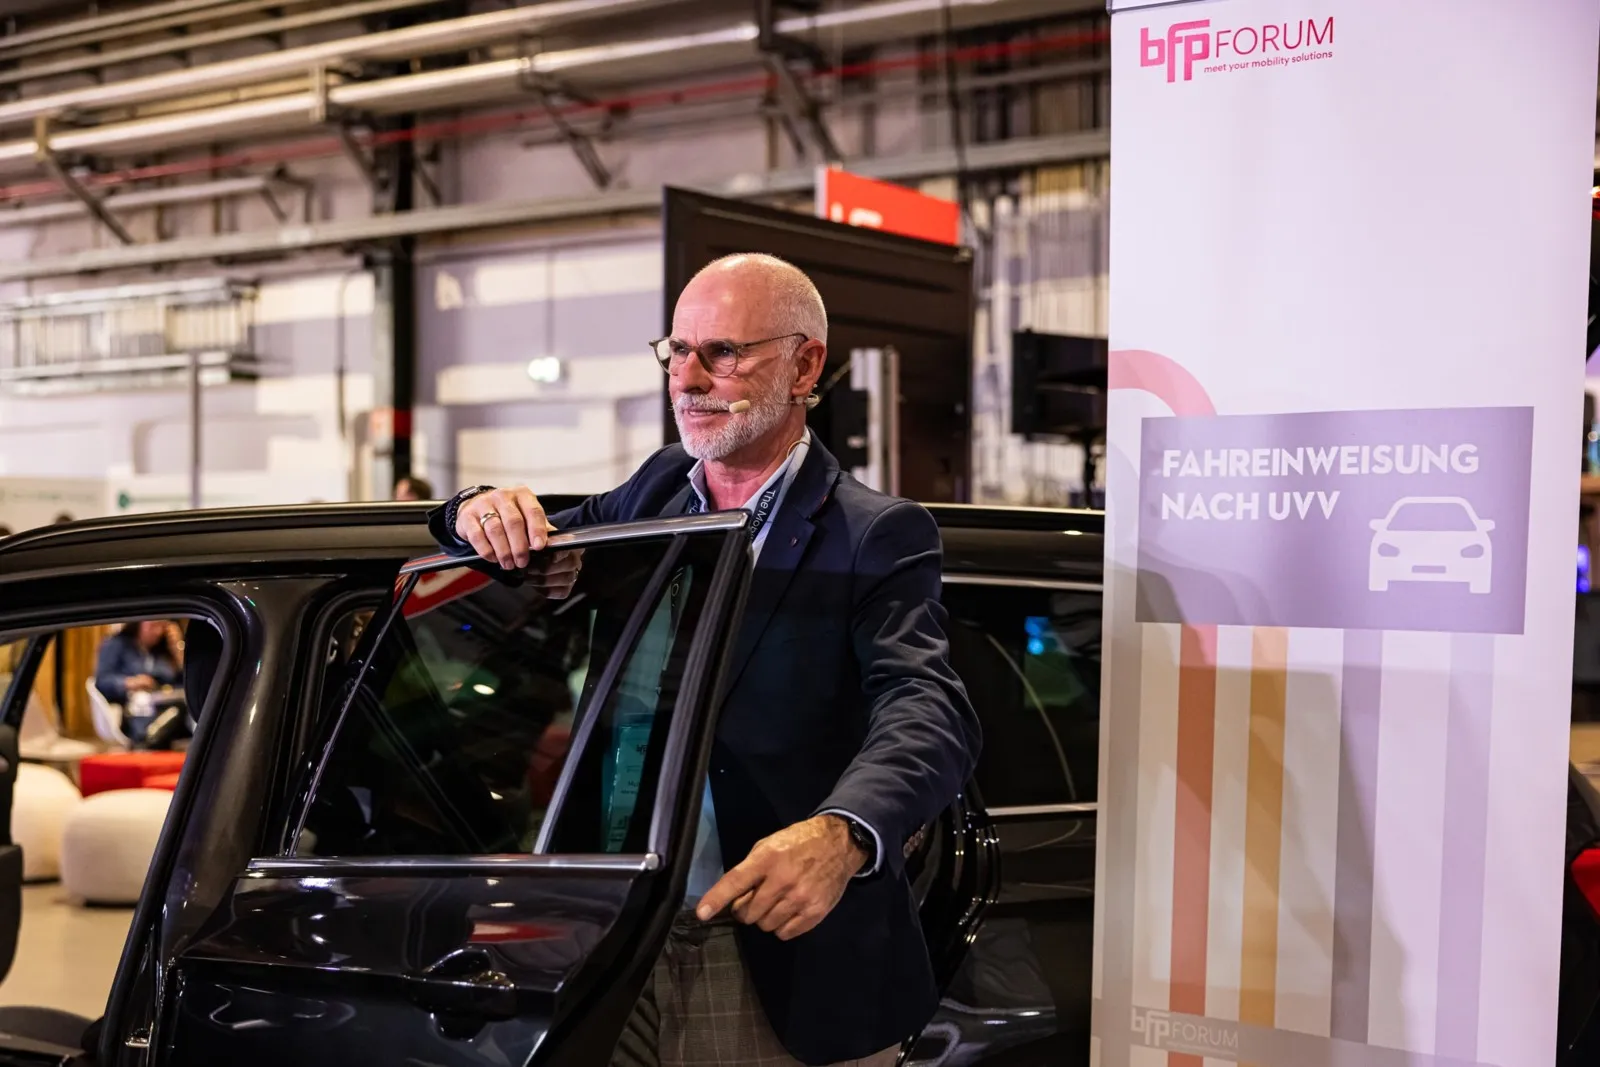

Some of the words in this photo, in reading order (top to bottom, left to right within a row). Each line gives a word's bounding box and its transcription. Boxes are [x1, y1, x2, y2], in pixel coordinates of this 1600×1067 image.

[1140, 19, 1210, 83] bfp
[1216, 16, 1334, 58] FORUM
[1204, 63, 1227, 73] meet
[1229, 62, 1250, 73] your
[1251, 55, 1290, 68] mobility
[1292, 50, 1333, 63] solutions
[1162, 444, 1480, 478] FAHREINWEISUNG
[760, 490, 776, 509] The
[1161, 492, 1259, 520] NACH
[1267, 490, 1341, 520] UVV
[1172, 1022, 1239, 1048] FORUM
